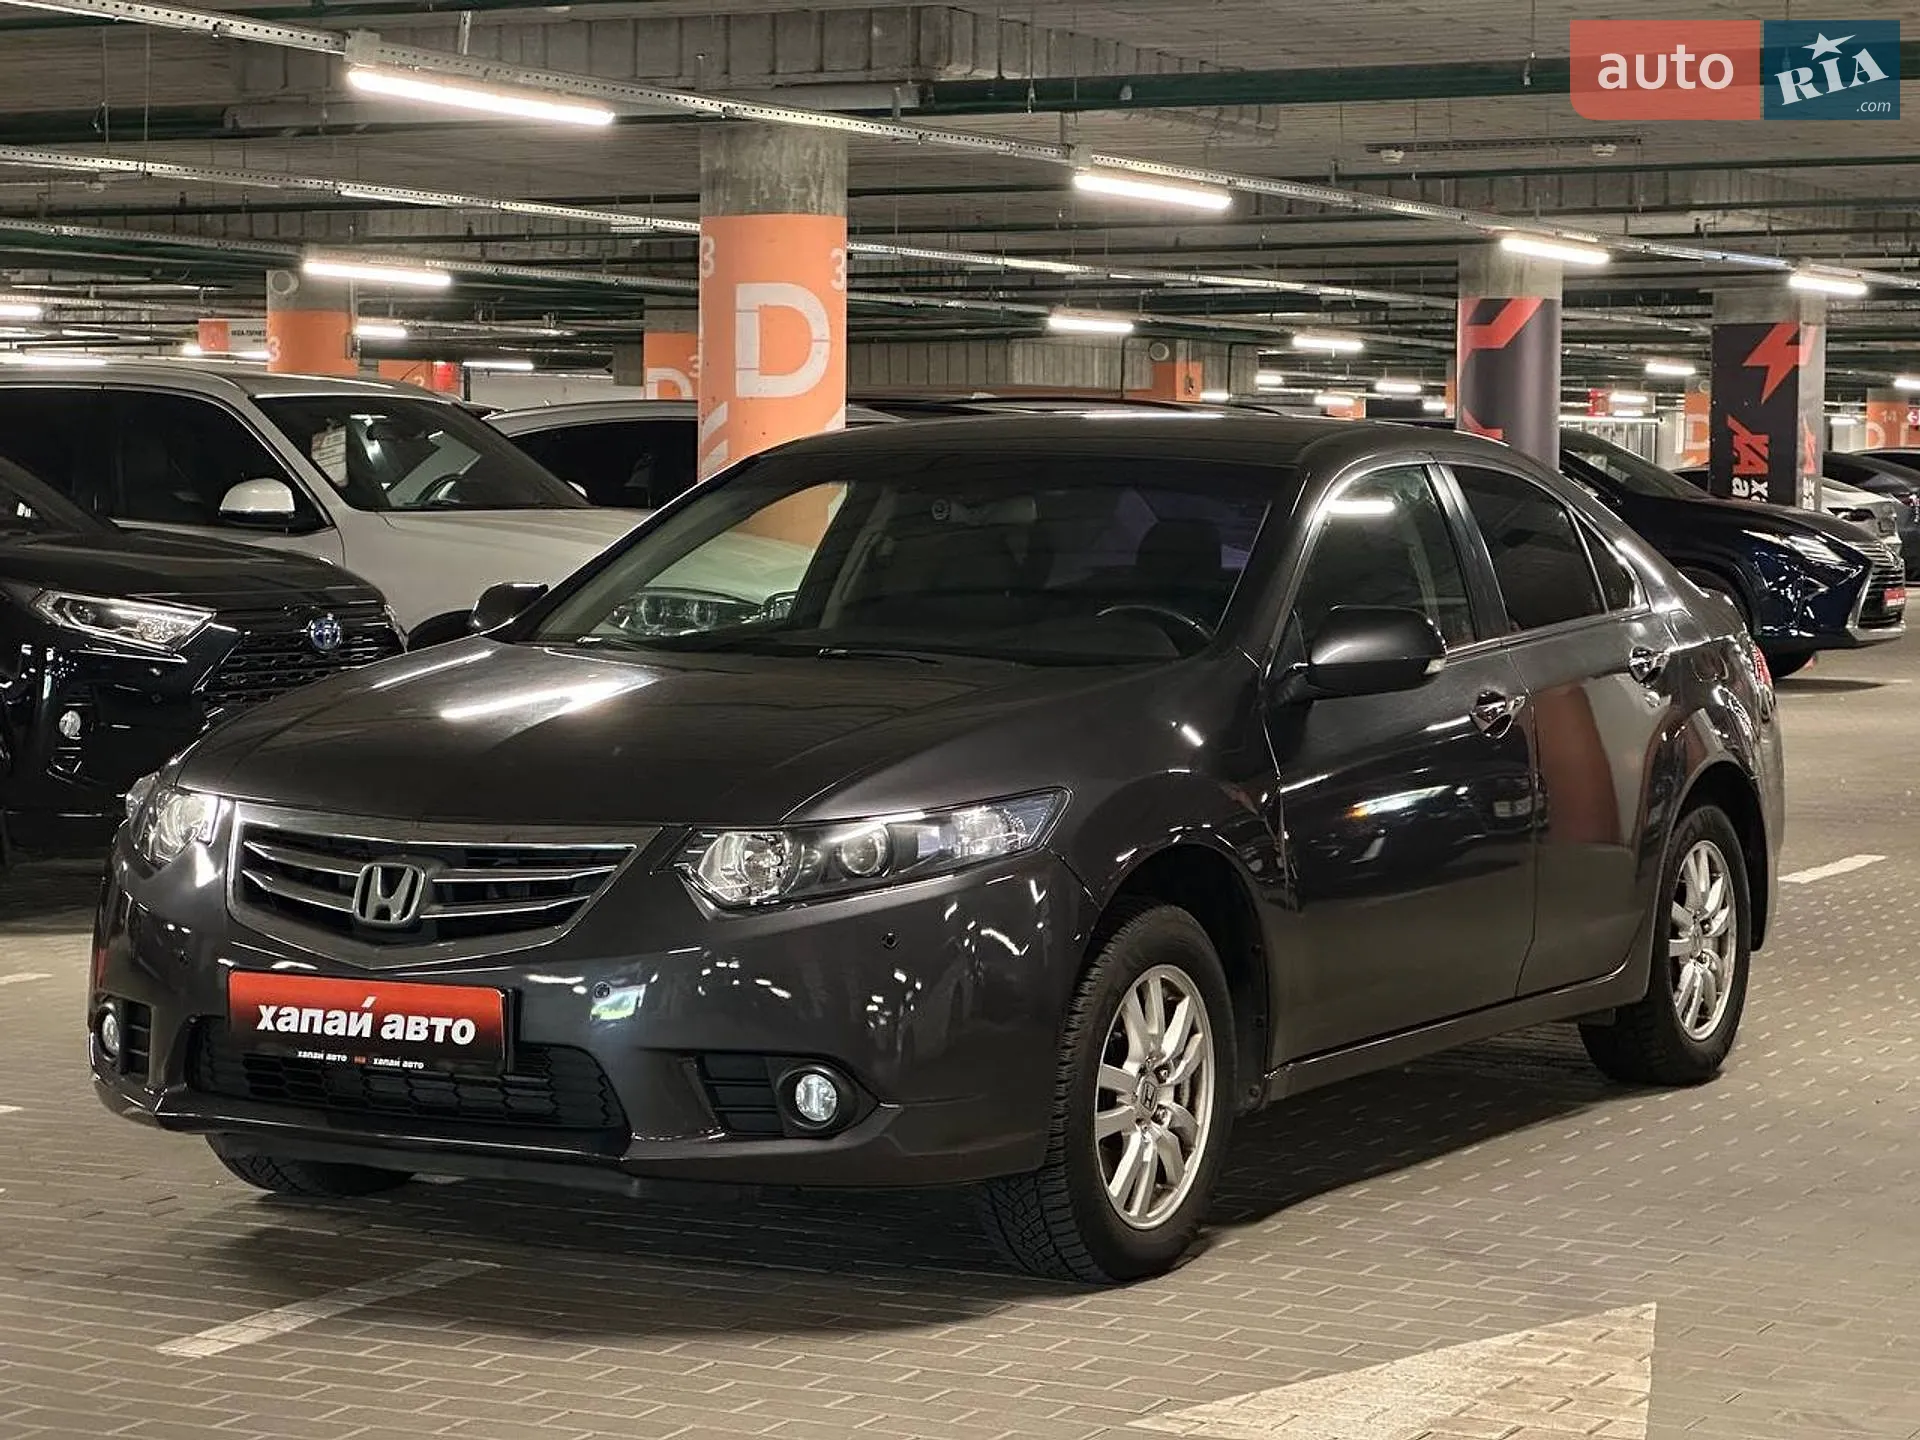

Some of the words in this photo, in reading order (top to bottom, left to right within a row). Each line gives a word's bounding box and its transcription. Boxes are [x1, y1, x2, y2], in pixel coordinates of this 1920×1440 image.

[829, 248, 846, 292] 3
[269, 336, 282, 363] 3
[735, 282, 831, 398] D
[380, 1013, 476, 1046] авто
